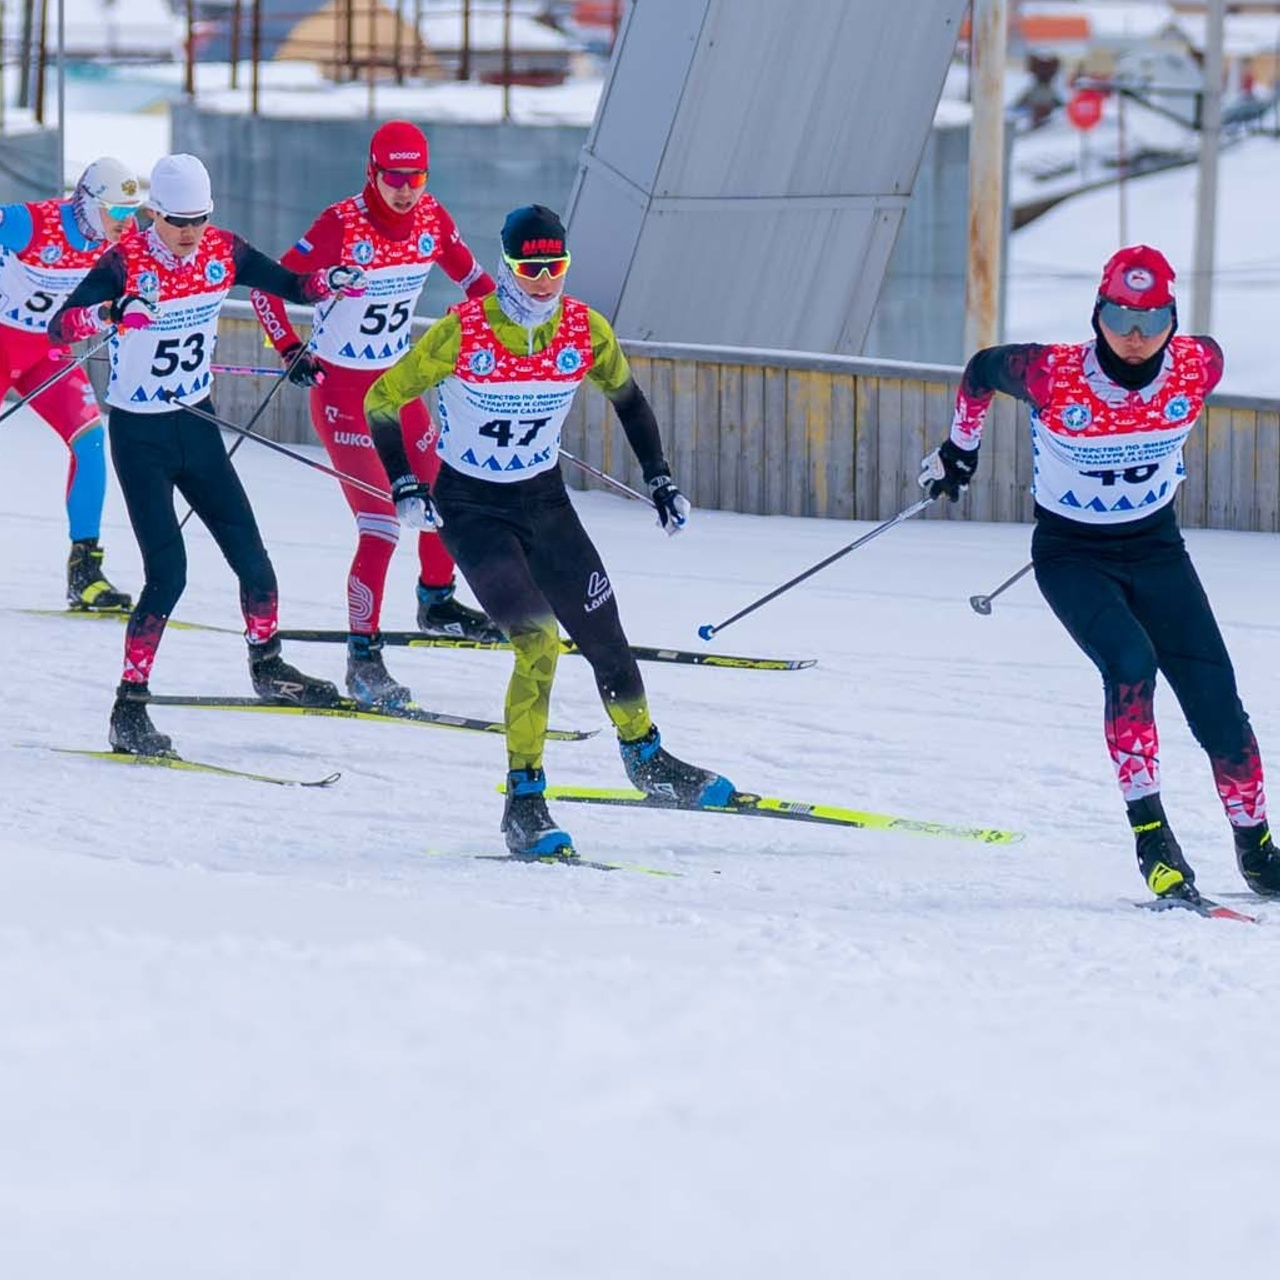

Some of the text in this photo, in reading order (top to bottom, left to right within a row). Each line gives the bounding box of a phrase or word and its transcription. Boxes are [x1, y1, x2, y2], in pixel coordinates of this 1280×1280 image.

[24, 290, 72, 313] 5
[359, 300, 411, 336] 55
[150, 332, 205, 377] 53
[478, 416, 552, 448] 47
